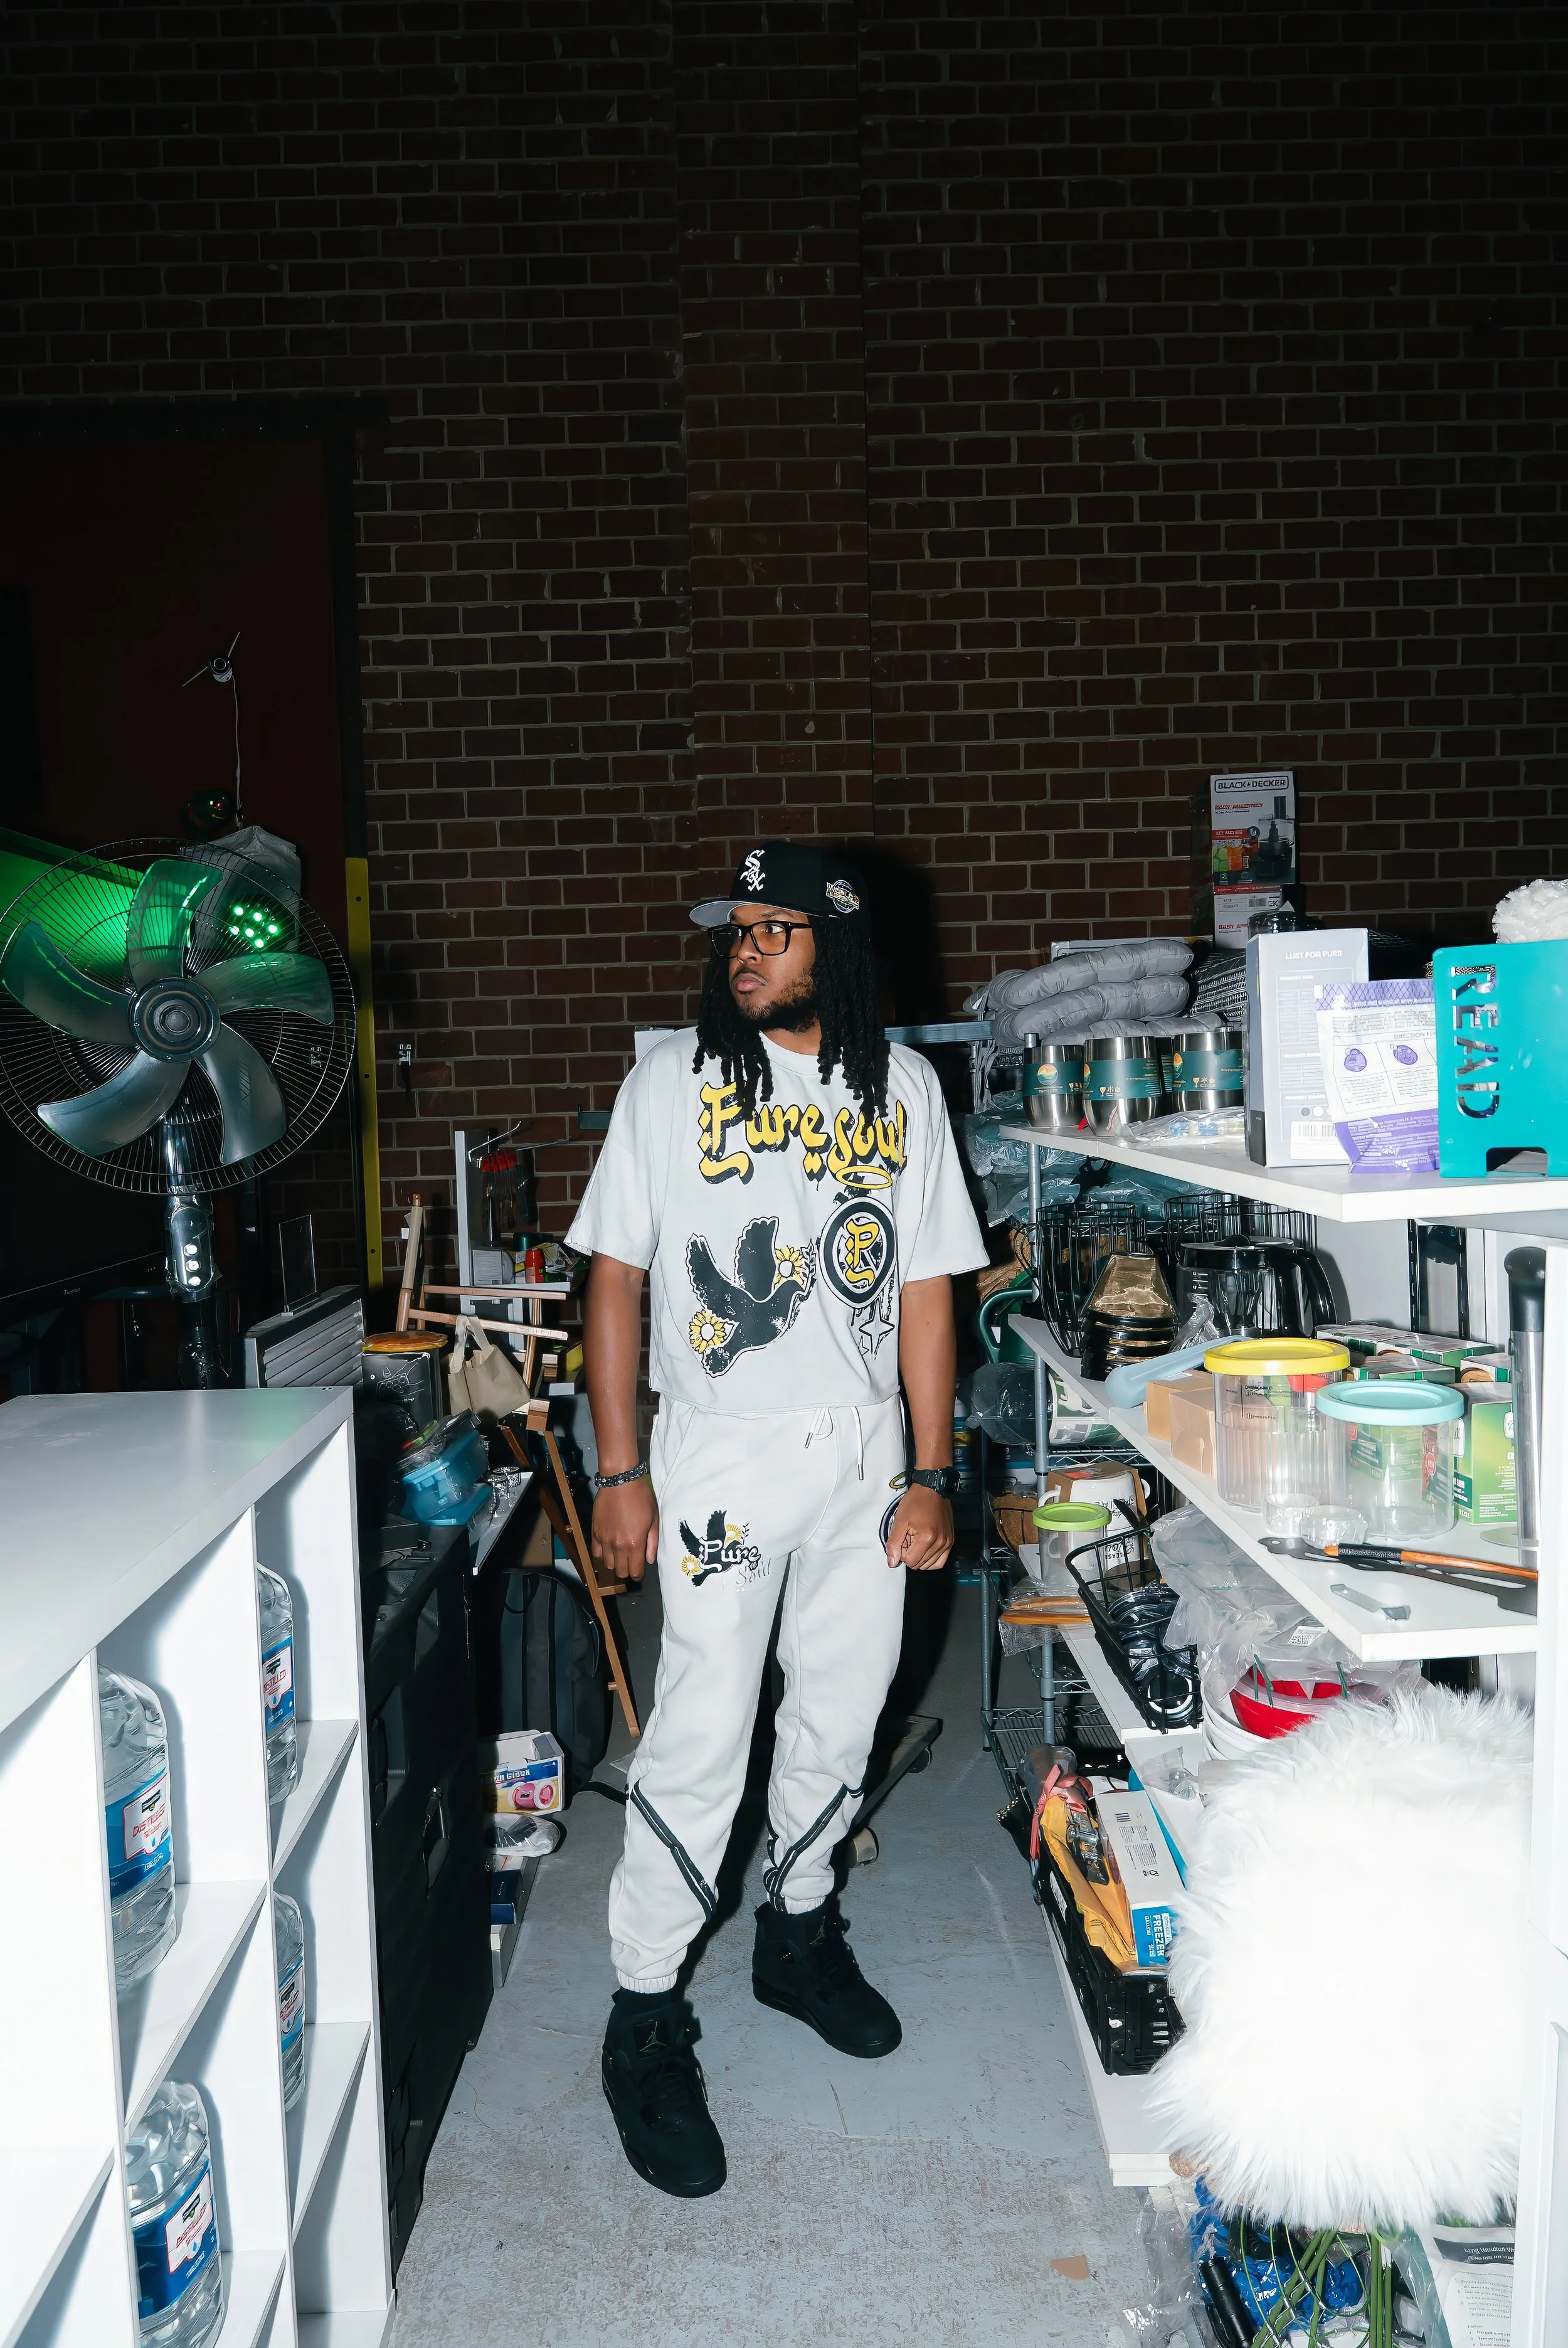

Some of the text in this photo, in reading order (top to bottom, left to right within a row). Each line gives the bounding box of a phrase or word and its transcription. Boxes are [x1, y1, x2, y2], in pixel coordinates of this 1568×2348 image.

[1305, 950, 1322, 959] FOR
[1450, 964, 1500, 1118] READ
[697, 1536, 762, 1573] Pure
